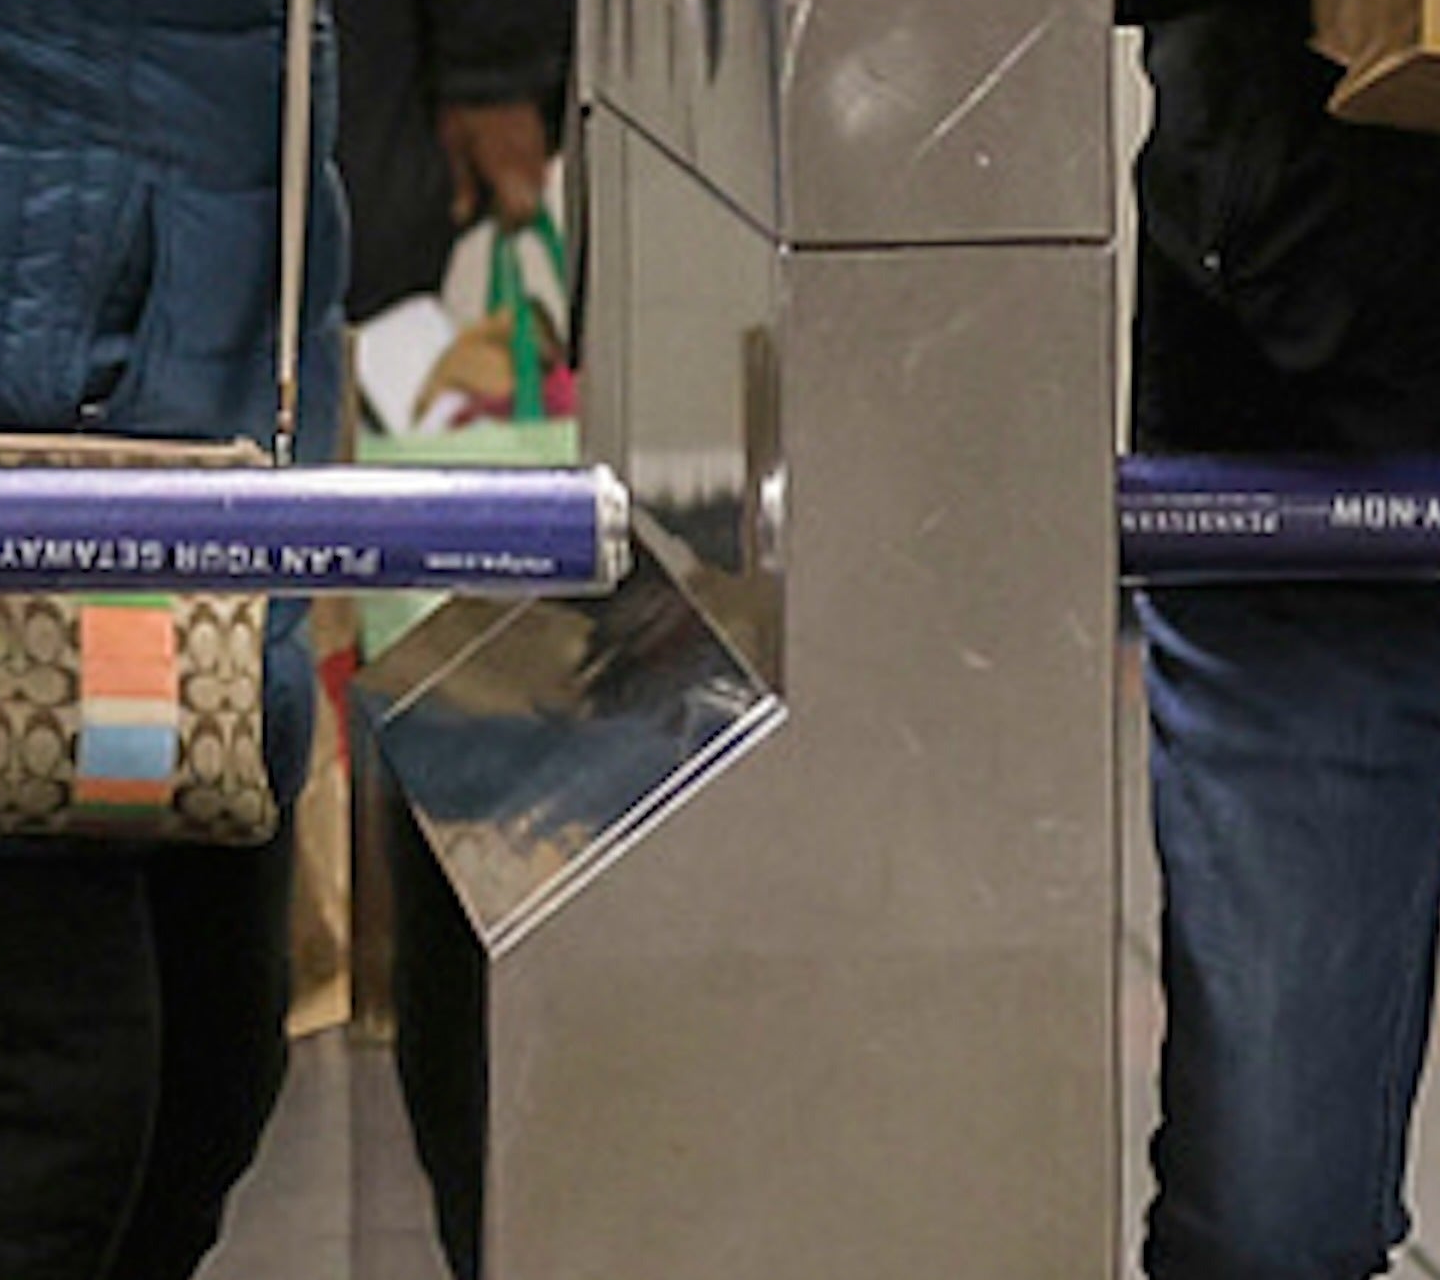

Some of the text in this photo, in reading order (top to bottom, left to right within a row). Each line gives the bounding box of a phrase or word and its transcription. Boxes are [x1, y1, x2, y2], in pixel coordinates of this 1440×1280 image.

[1330, 495, 1416, 527] NOW
[0, 537, 163, 572] GETAWAY
[176, 541, 269, 573] YOUR
[281, 545, 380, 575] PLAN
